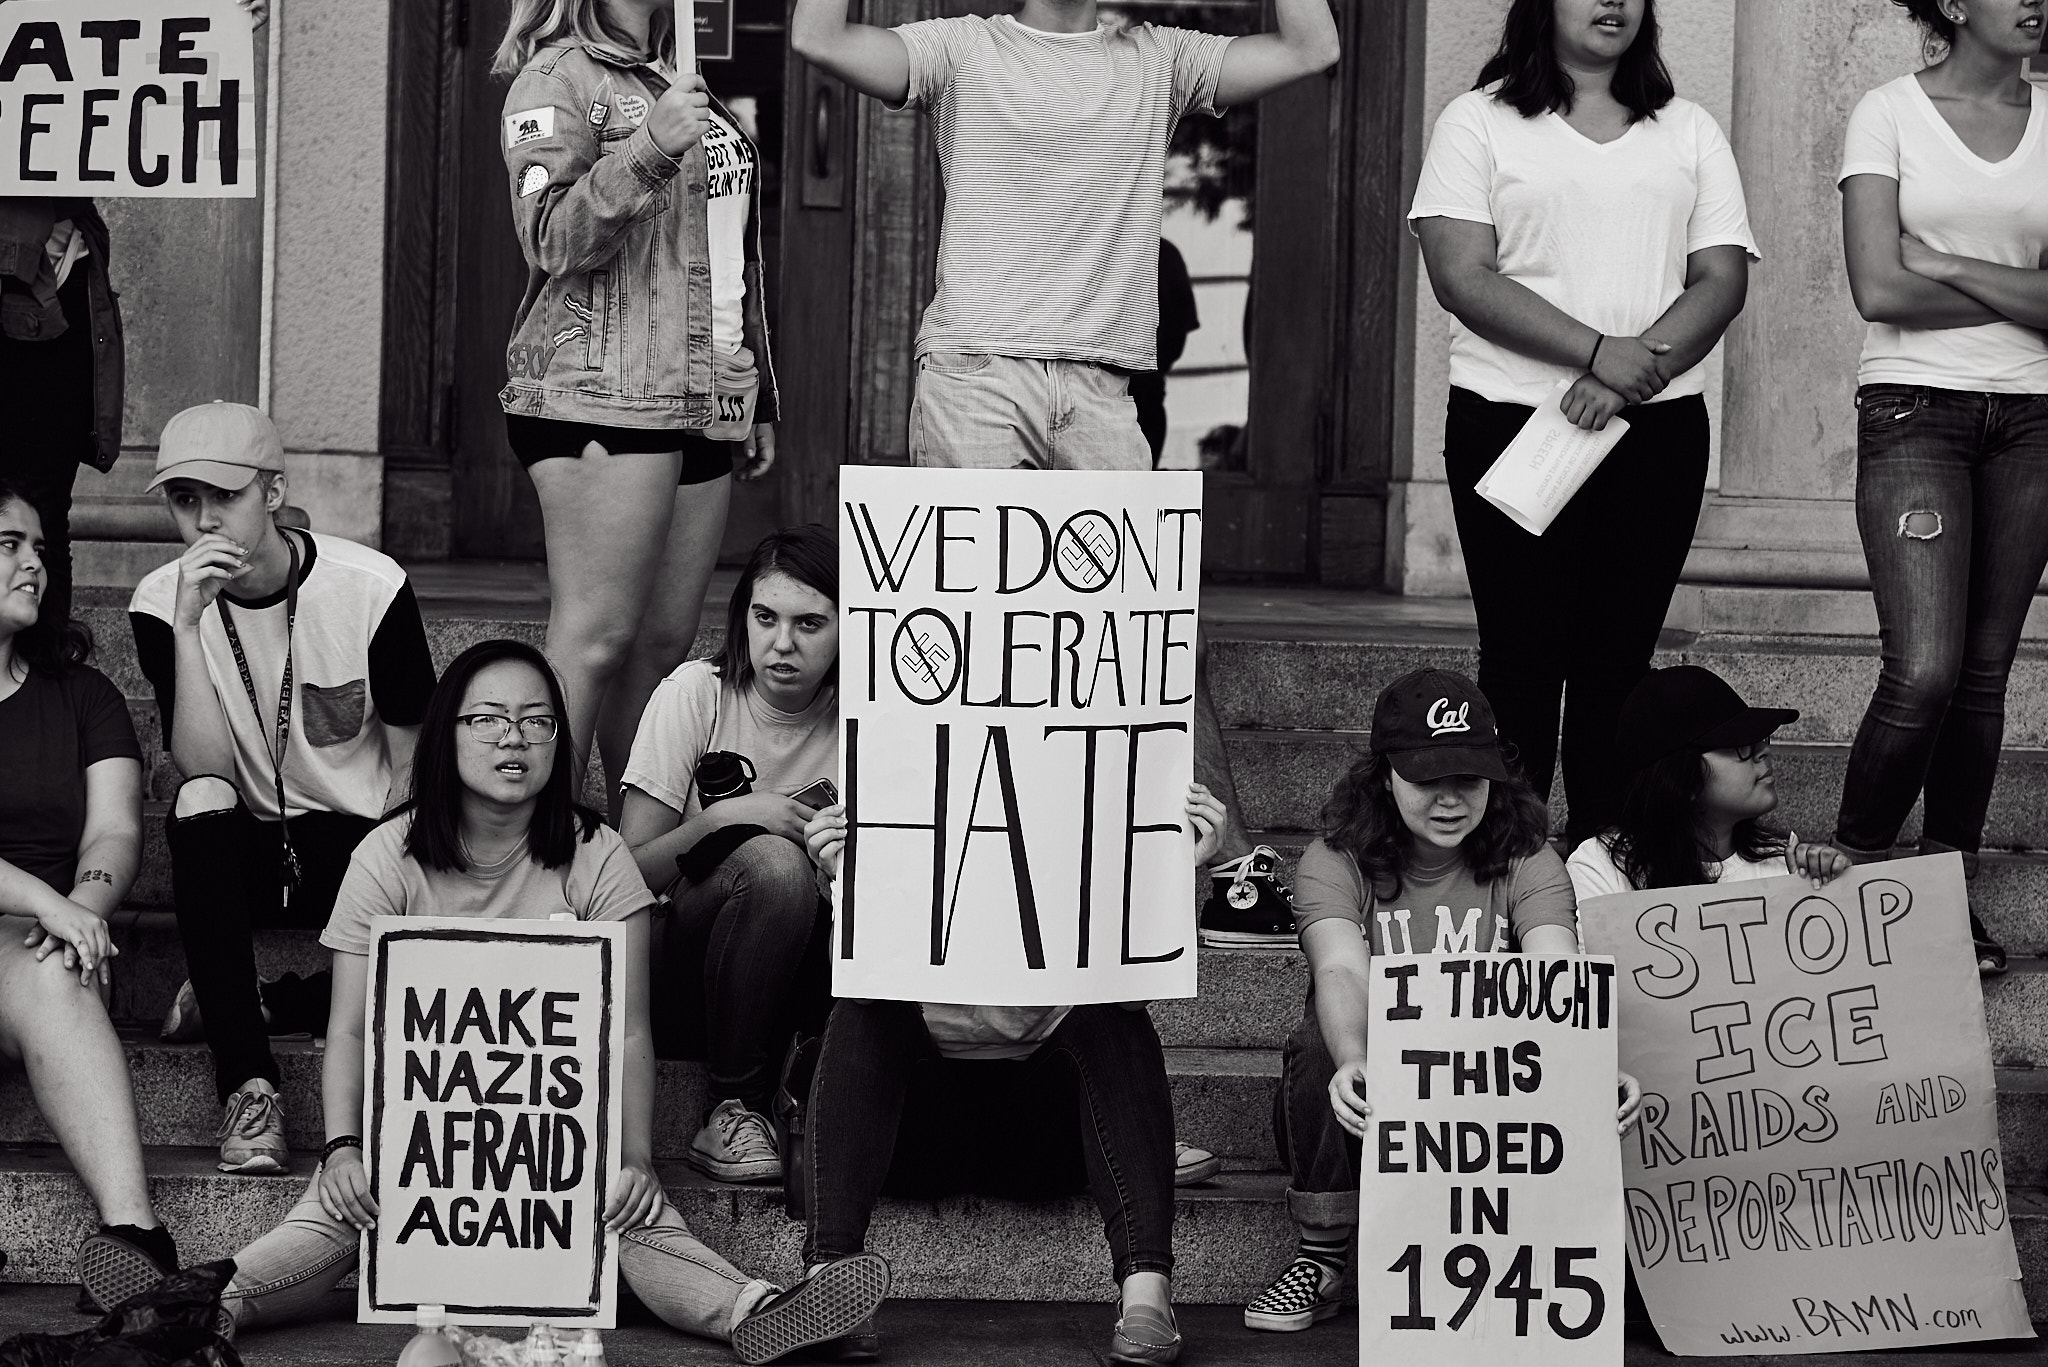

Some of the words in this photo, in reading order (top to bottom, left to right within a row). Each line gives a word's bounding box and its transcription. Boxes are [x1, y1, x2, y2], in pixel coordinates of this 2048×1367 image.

[0, 17, 210, 82] ATE
[705, 144, 731, 170] GOT
[508, 342, 556, 380] SEXY
[845, 502, 981, 593] WE
[848, 607, 1195, 709] TOLERATE
[1426, 697, 1471, 737] Cal
[841, 718, 1188, 970] HATE
[1633, 878, 1913, 999] STOP
[404, 987, 579, 1047] MAKE
[1385, 964, 1422, 1021] I
[1441, 958, 1614, 1029] THOUGHT
[1690, 984, 1888, 1084] ICE
[404, 1050, 583, 1109] NAZIS
[1402, 1041, 1541, 1099] THIS
[399, 1108, 586, 1193] AFRAID
[1379, 1121, 1563, 1174] ENDED
[1637, 1085, 1839, 1169] RAIDS
[1875, 1075, 1967, 1126] AND
[396, 1196, 572, 1249] AGAIN
[1450, 1187, 1508, 1235] IN
[1624, 1148, 2006, 1269] DEPORTATIONS
[1387, 1244, 1605, 1339] 1945
[1720, 1293, 1982, 1344] www.BAMN.com
